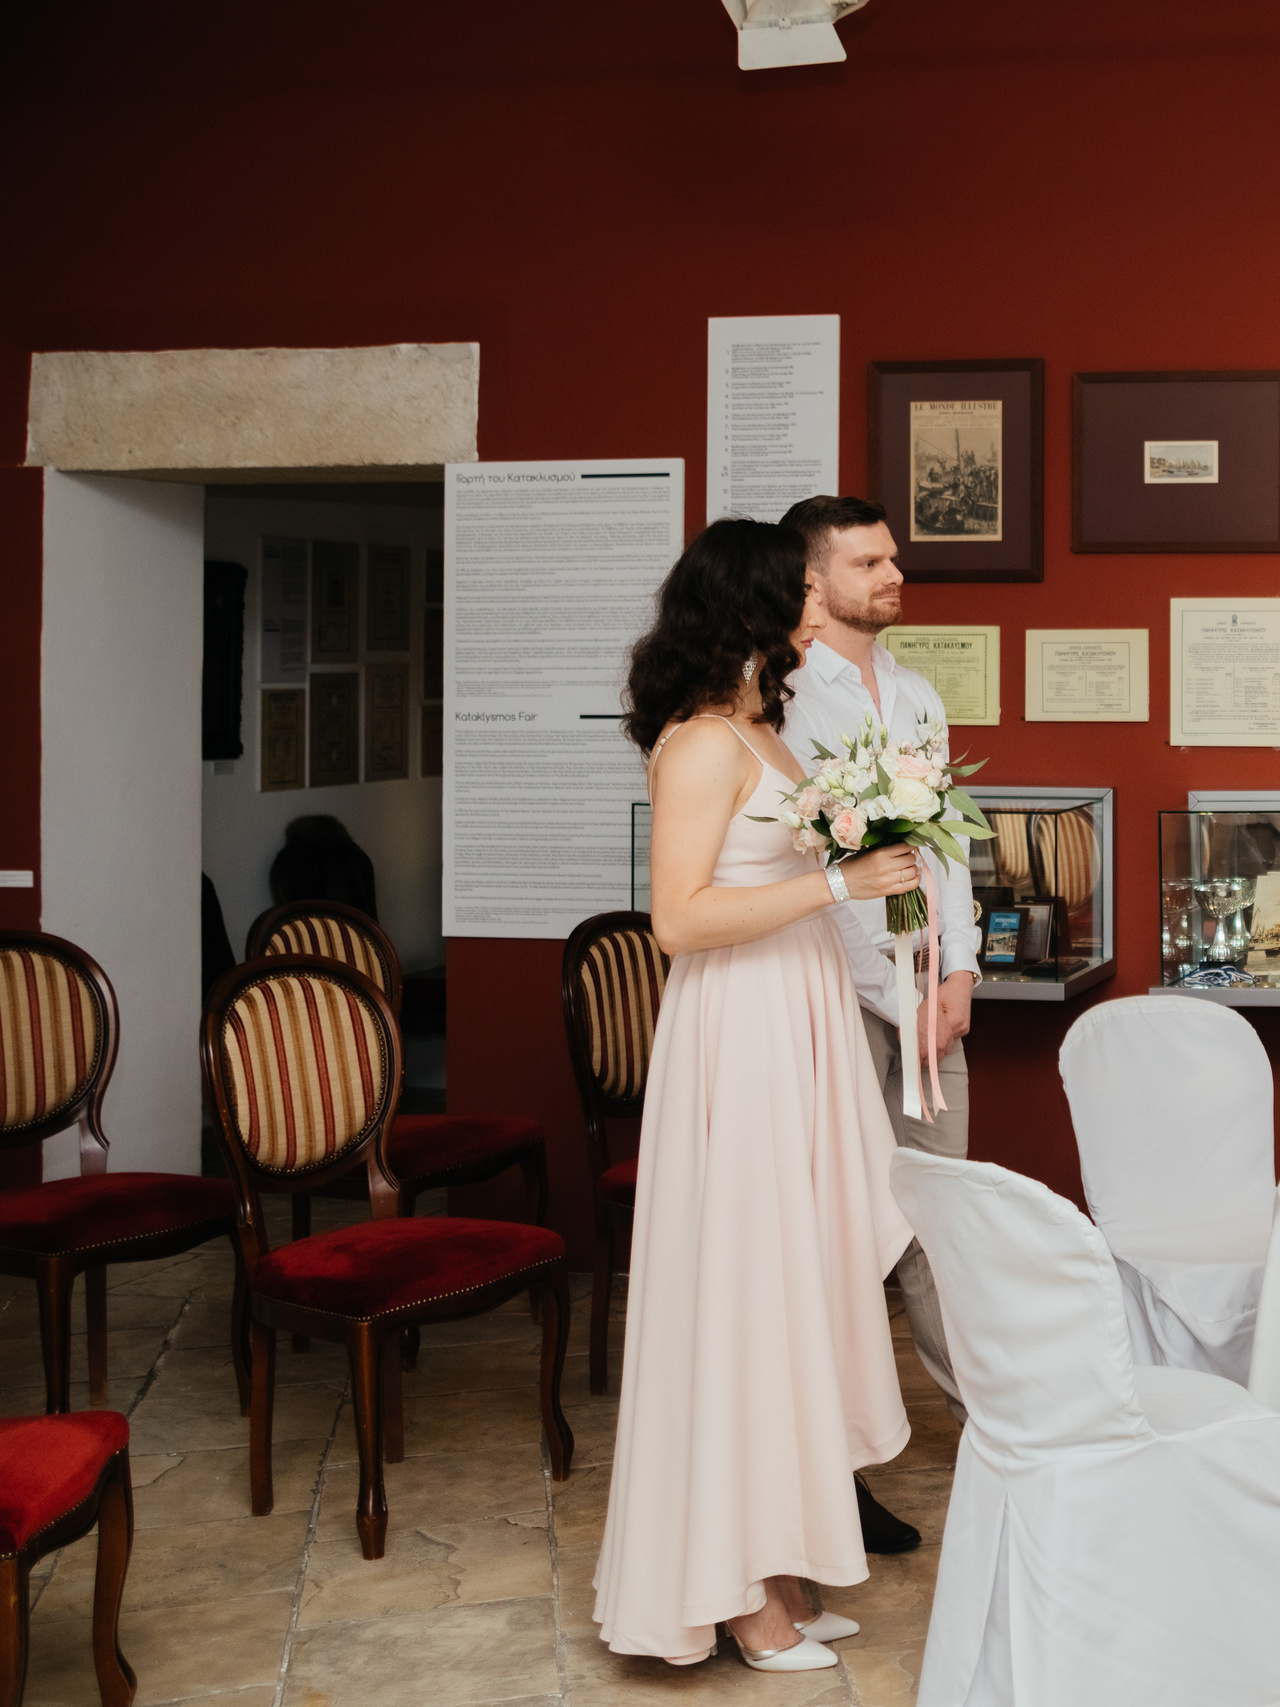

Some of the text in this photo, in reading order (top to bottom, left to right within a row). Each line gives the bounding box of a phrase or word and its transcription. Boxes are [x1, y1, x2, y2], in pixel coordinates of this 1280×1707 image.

[488, 475, 505, 483] του
[507, 472, 576, 484] Κατακλυσμού
[455, 712, 538, 724] Kataklysmos Fair
